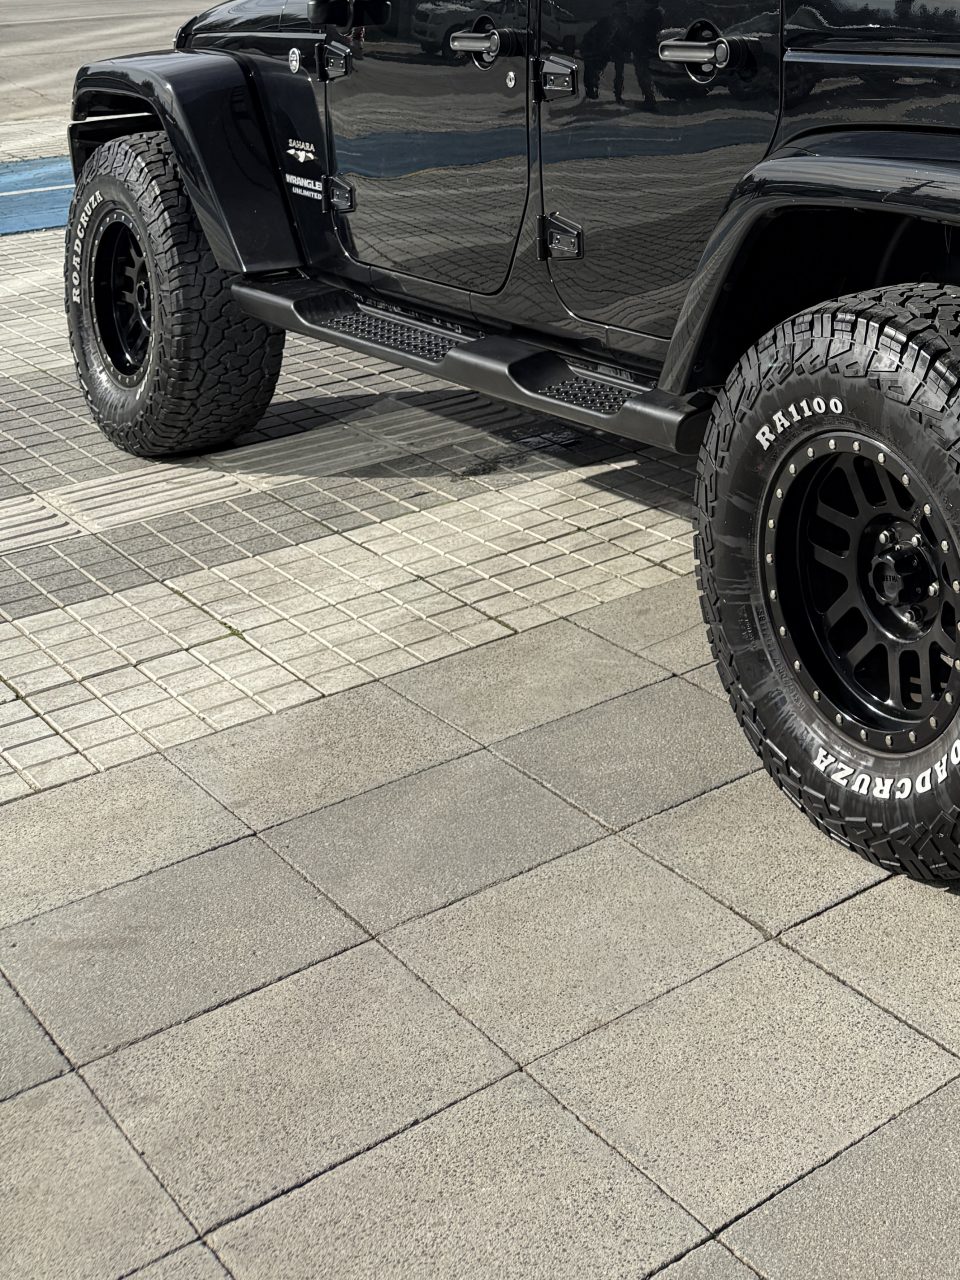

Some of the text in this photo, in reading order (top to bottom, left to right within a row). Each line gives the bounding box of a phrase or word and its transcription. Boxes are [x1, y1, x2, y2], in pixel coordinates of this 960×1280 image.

[288, 138, 316, 152] SAHARA
[285, 173, 323, 191] WRANGLE
[292, 186, 323, 200] UNLIMITED
[72, 190, 104, 304] ROADCRUZA
[755, 397, 843, 451] RA1100
